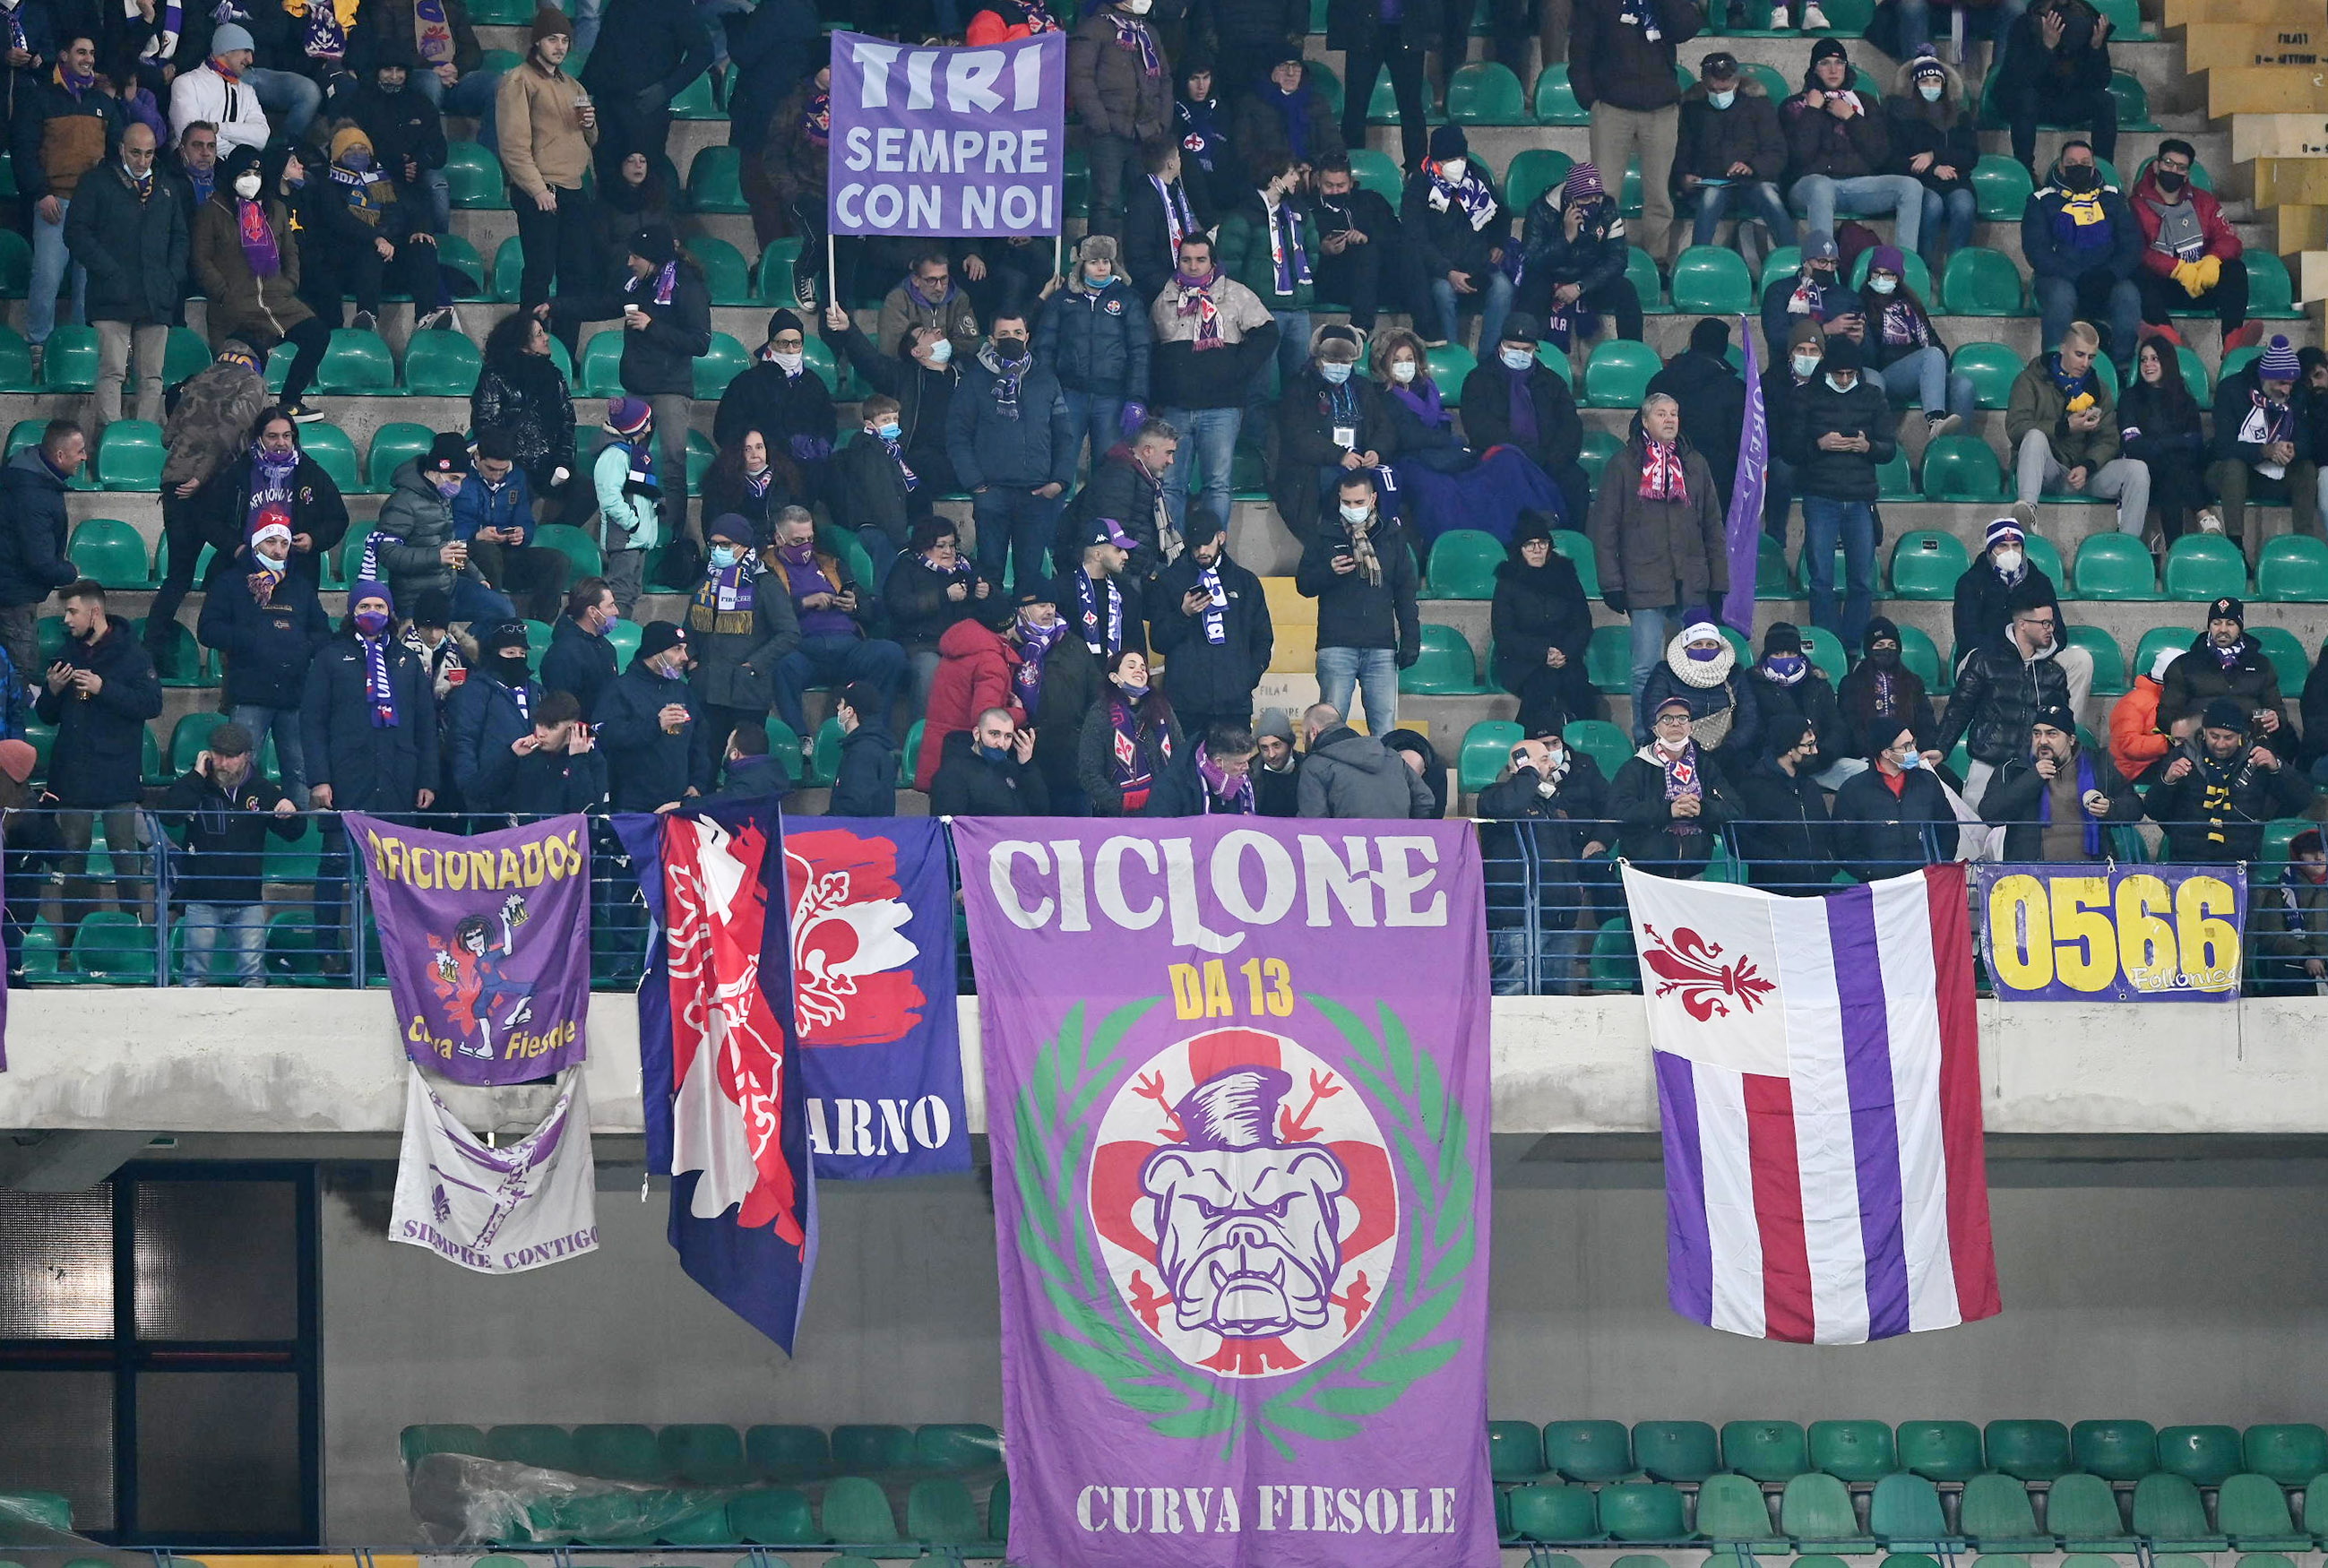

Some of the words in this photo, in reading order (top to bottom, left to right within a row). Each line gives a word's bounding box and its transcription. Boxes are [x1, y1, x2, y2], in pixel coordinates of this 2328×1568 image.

[852, 43, 1044, 114] TIRI
[845, 126, 1048, 173] SEMPRE
[836, 183, 941, 229] CON
[961, 185, 1053, 229] NOI
[1260, 685, 1280, 695] FILA
[1282, 684, 1289, 694] 4
[368, 828, 582, 891] AFICIONADOS
[989, 829, 1447, 953] CICLONE
[1989, 874, 2240, 992] 0566
[1168, 959, 1233, 1020] DA
[1241, 957, 1294, 1017] 13
[806, 1095, 951, 1157] ARNO
[403, 1219, 492, 1269] SIEMPRE
[503, 1226, 599, 1270] CONTIGO
[1076, 1485, 1241, 1533] CURVA
[1257, 1486, 1456, 1534] FIESOLE
